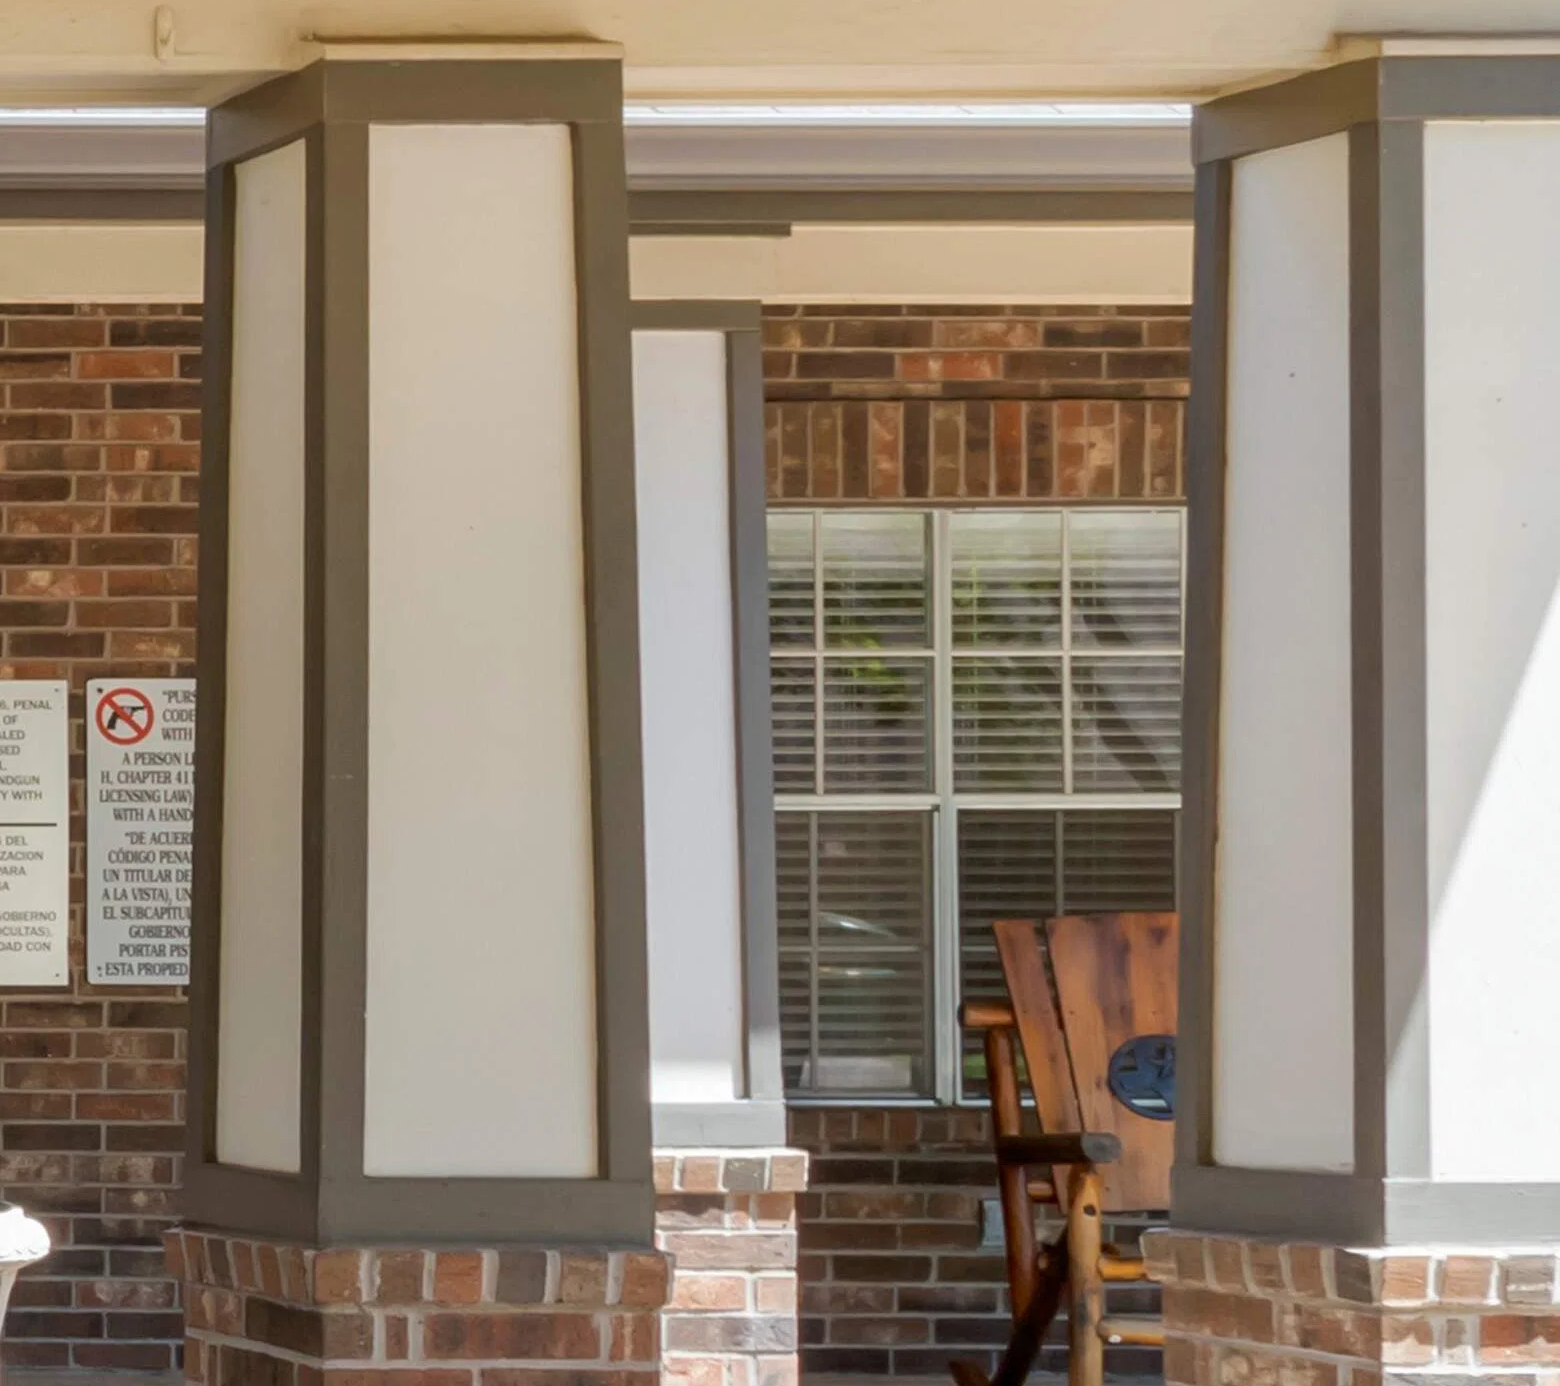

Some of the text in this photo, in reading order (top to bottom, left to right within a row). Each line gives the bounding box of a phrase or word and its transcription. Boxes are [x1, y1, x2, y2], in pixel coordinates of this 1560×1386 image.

[14, 700, 52, 710] PENAL
[2, 715, 18, 725] OF
[162, 727, 193, 741] WITH
[122, 753, 131, 766] A
[134, 753, 181, 766] PERSON
[117, 771, 173, 784] CHAPTER
[12, 791, 43, 801] WITH
[99, 789, 161, 803] LICENSING
[113, 808, 144, 822] WITH
[147, 808, 157, 822] A
[6, 835, 28, 846] DEL
[108, 847, 156, 864] CÓDIGO
[102, 869, 120, 882] UN
[124, 869, 172, 882] TITULAR
[102, 888, 111, 902] A
[113, 888, 128, 902] LA
[102, 907, 117, 920] EL
[26, 941, 52, 952] CON
[119, 944, 166, 957] PORTAR
[105, 963, 135, 977] ESTA
